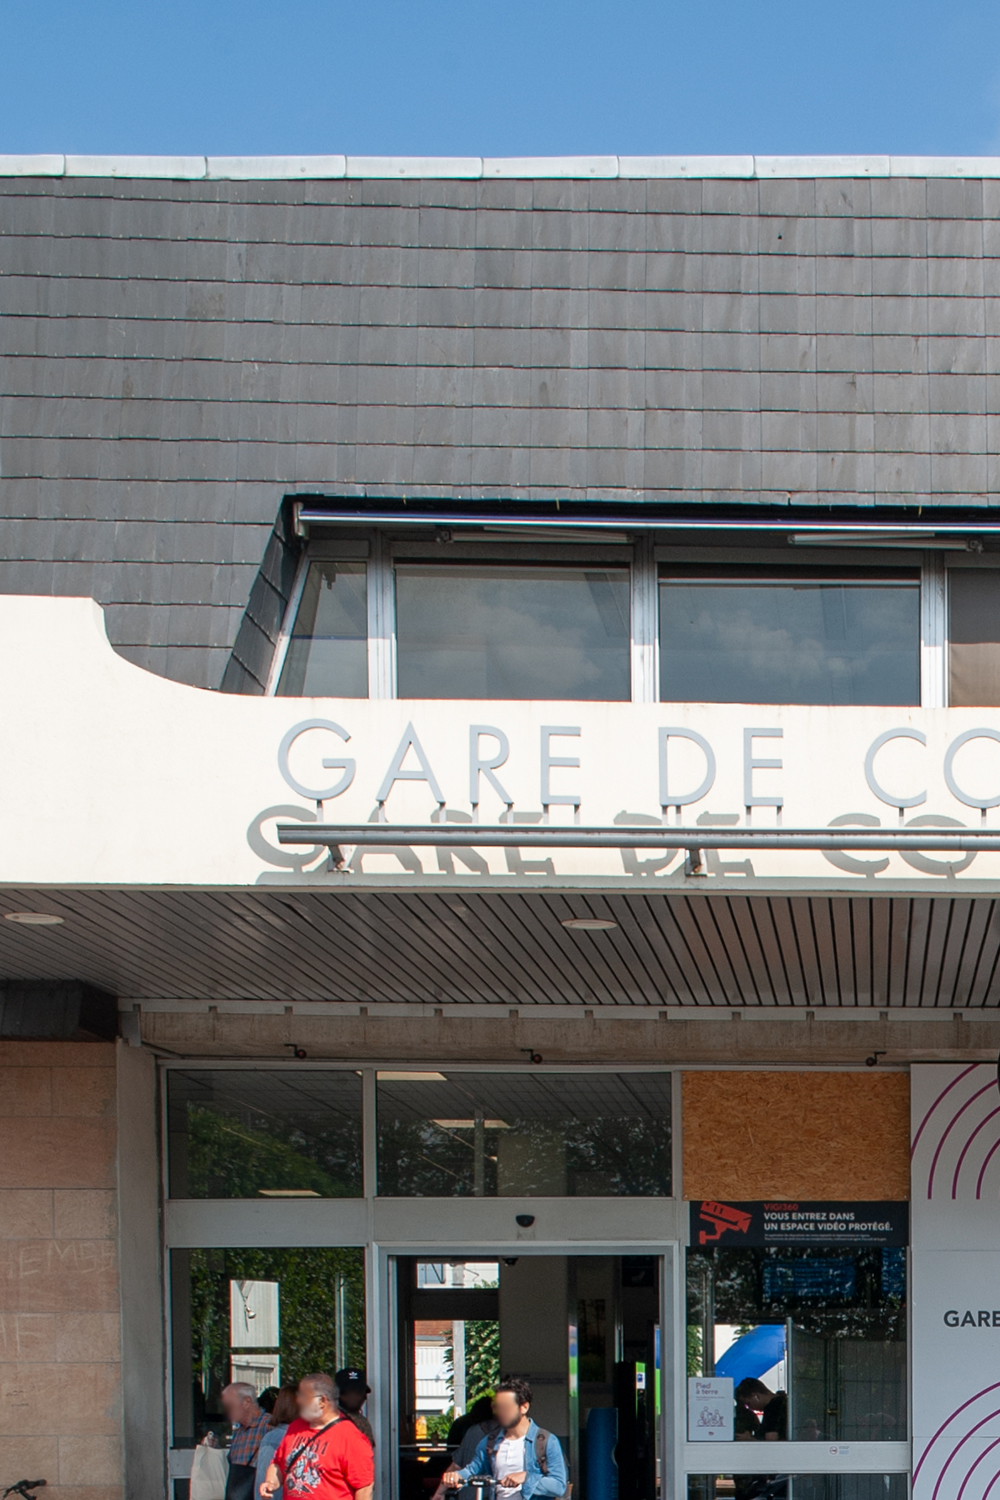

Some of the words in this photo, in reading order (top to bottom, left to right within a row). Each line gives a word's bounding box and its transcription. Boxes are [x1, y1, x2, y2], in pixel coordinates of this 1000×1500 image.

[277, 718, 581, 806] GARE
[658, 726, 783, 808] DE
[763, 1203, 798, 1211] VIGI360
[764, 1212, 790, 1220] VOUS
[792, 1212, 827, 1220] ENTREZ
[829, 1212, 855, 1220] DANS
[764, 1222, 778, 1231] UN
[780, 1222, 815, 1231] ESPACE
[817, 1221, 847, 1231] VIDÉO
[848, 1221, 893, 1231] PROTÉGÉ.
